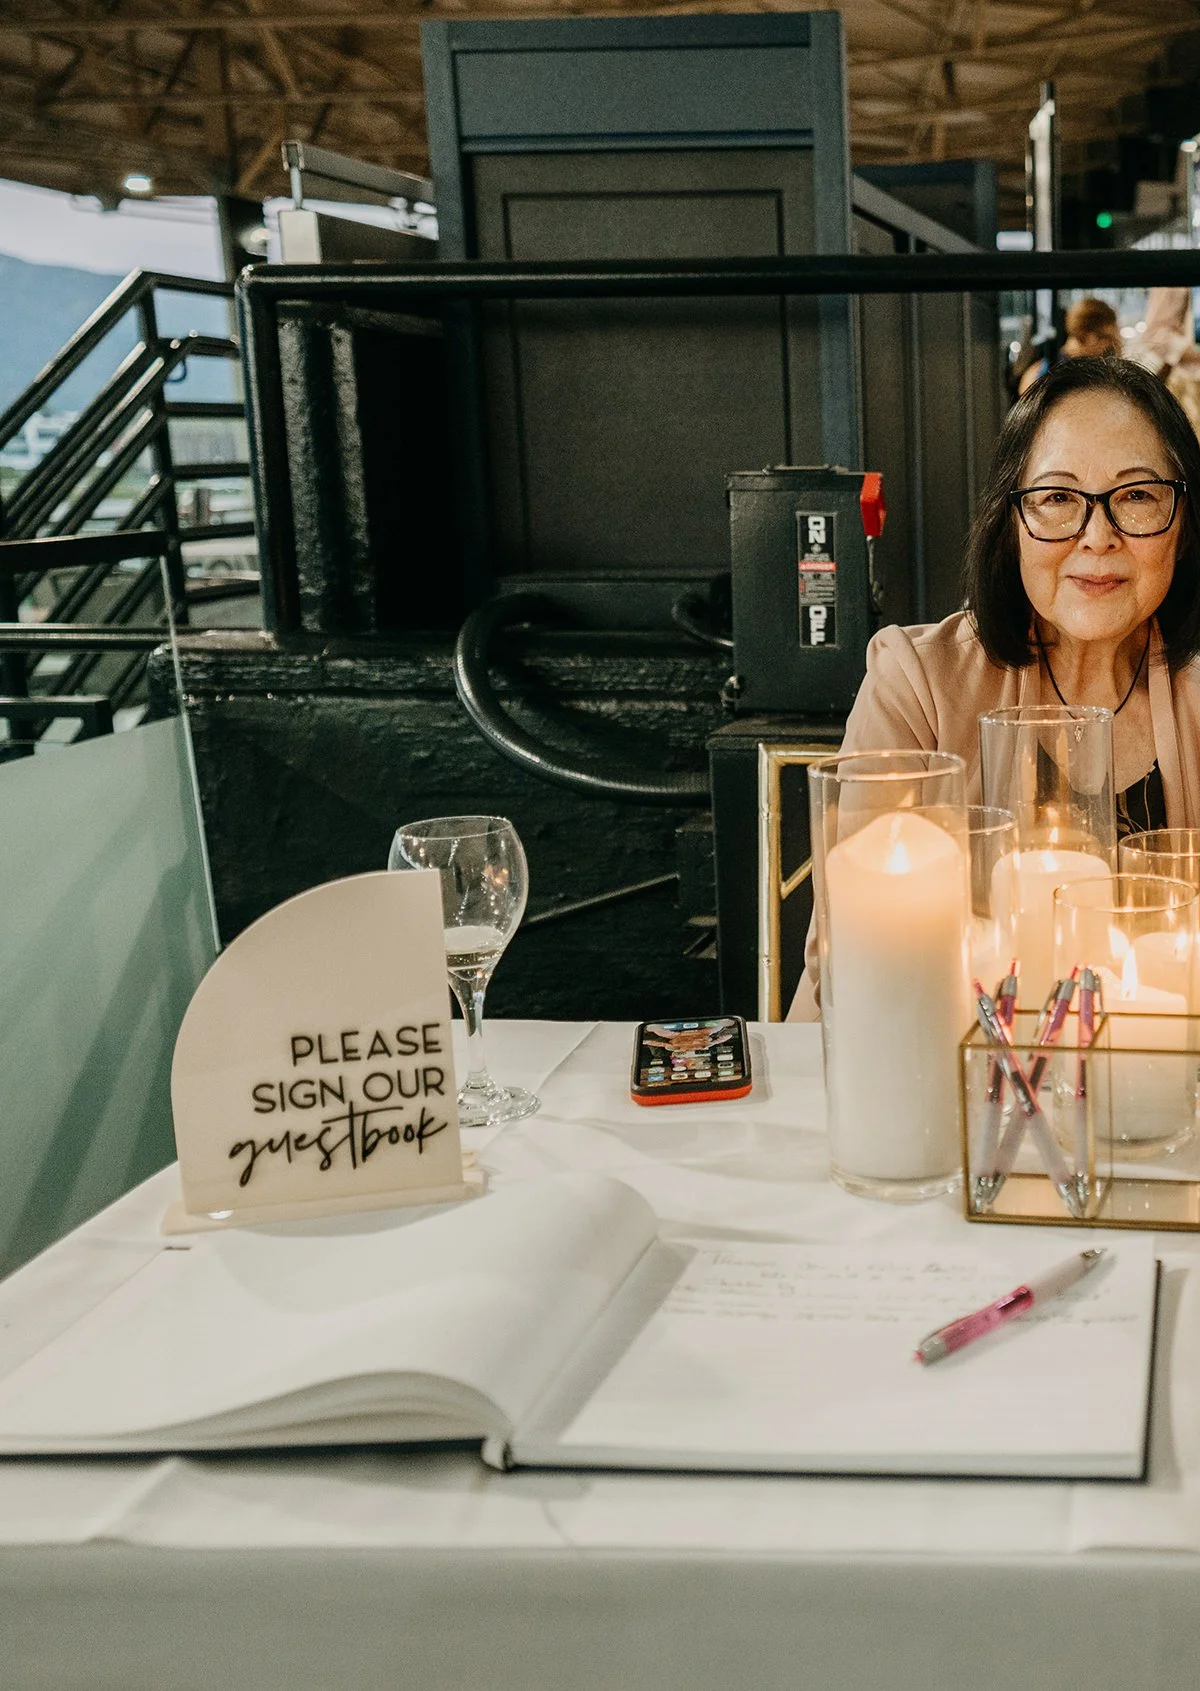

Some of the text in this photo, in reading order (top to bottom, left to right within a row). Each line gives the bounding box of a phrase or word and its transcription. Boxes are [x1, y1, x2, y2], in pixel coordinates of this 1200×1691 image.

[807, 515, 826, 544] ON
[809, 605, 827, 646] OFF
[291, 1022, 443, 1066] PLEASE
[251, 1066, 445, 1114] SIGN OUR
[228, 1100, 449, 1188] guestbook
